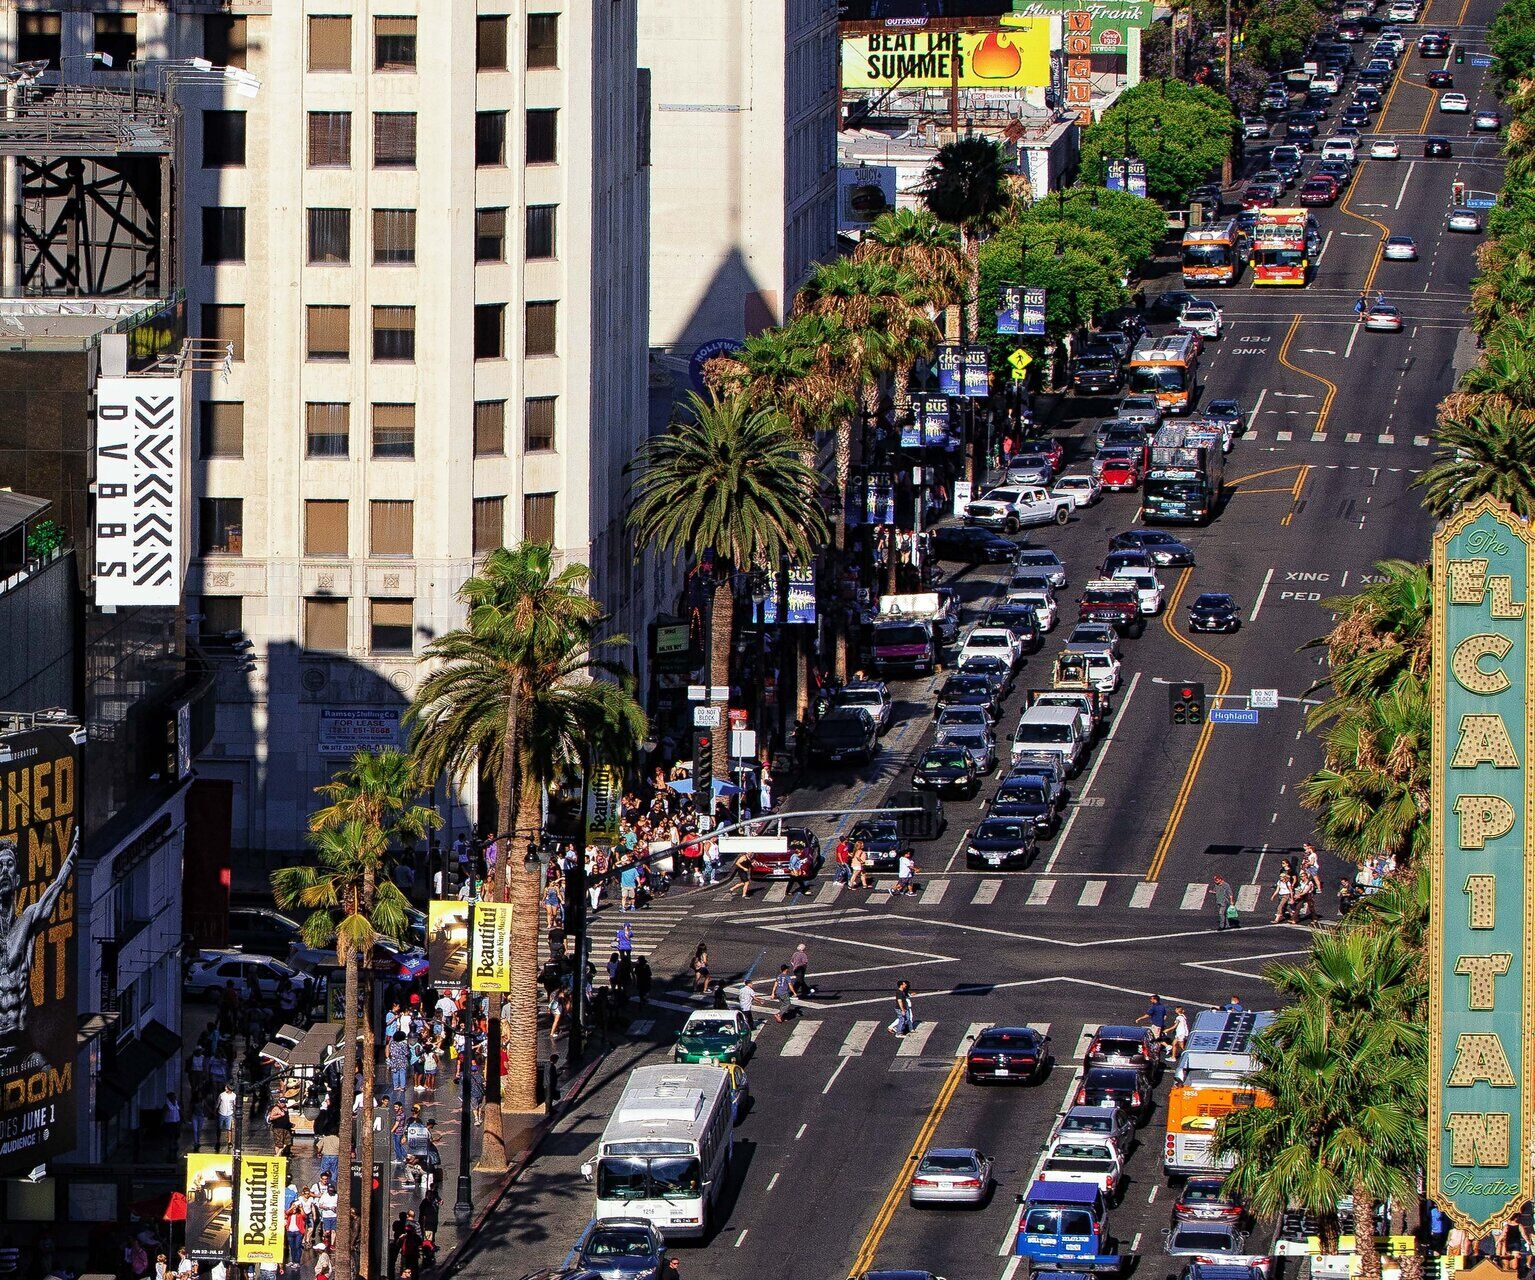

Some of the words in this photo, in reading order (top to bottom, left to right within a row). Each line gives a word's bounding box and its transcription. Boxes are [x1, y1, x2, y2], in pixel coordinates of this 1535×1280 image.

[868, 33, 915, 52] BEAT
[867, 54, 964, 79] SUMMER
[96, 405, 129, 578] DVBBS
[1465, 527, 1509, 556] The
[1360, 574, 1392, 584] XIN
[1446, 558, 1526, 620] EL
[1280, 591, 1321, 601] PED
[1215, 712, 1253, 722] Highland
[1446, 632, 1520, 1169] CAPITAN
[477, 907, 497, 978] Beautiful
[20, 1107, 46, 1133] JUNE
[268, 1161, 277, 1188] Musical
[1444, 1171, 1520, 1196] Theatre
[244, 1161, 268, 1246] Beautiful
[268, 1190, 279, 1207] King
[268, 1209, 277, 1231] Carole
[268, 1232, 277, 1246] The
